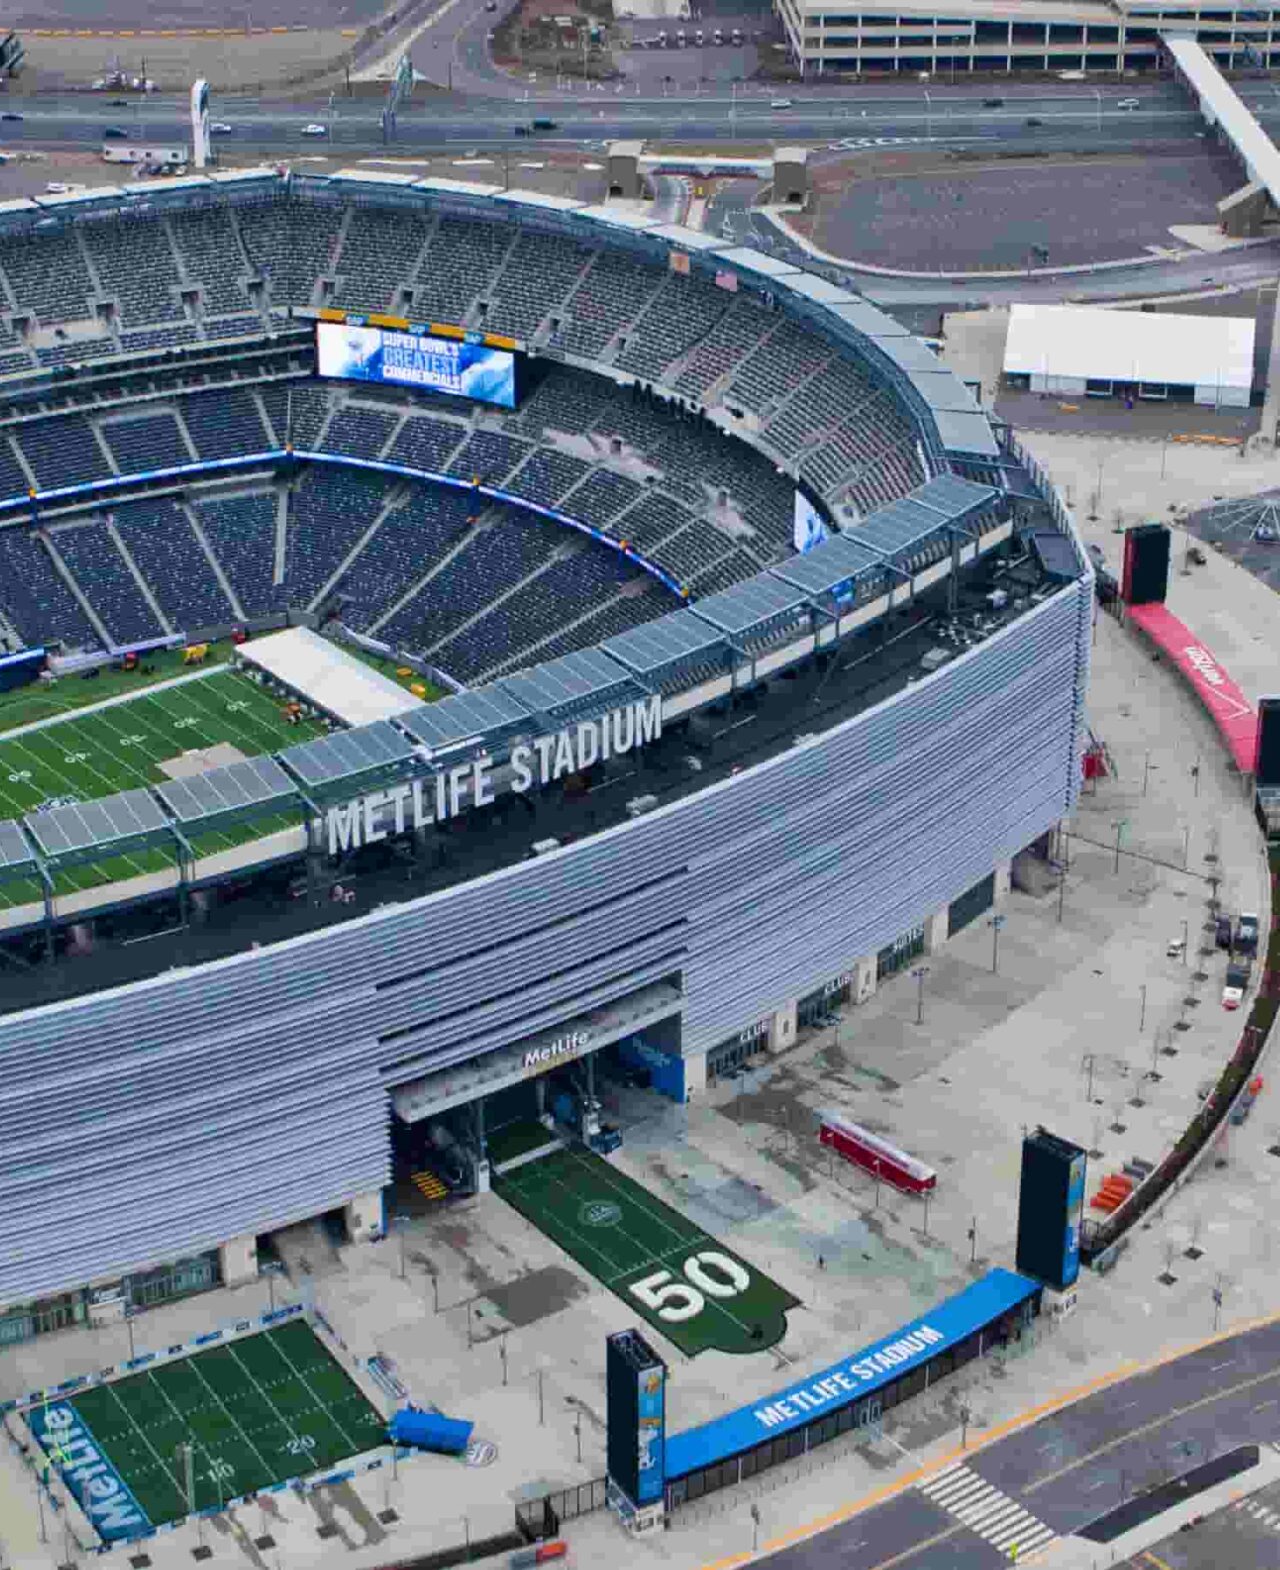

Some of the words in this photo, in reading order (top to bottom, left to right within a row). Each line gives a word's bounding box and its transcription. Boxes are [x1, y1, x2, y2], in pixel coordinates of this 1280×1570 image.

[382, 346, 459, 375] GREATEST
[328, 757, 495, 856] METLIFE
[510, 694, 663, 793] STADIUM
[524, 1031, 589, 1067] MetLife
[629, 1251, 750, 1322] 50
[754, 1372, 858, 1428] METLIFE
[849, 1324, 945, 1380] STADIUM
[41, 1407, 142, 1529] MetLife
[208, 1456, 236, 1483] 10
[286, 1434, 316, 1455] 20
